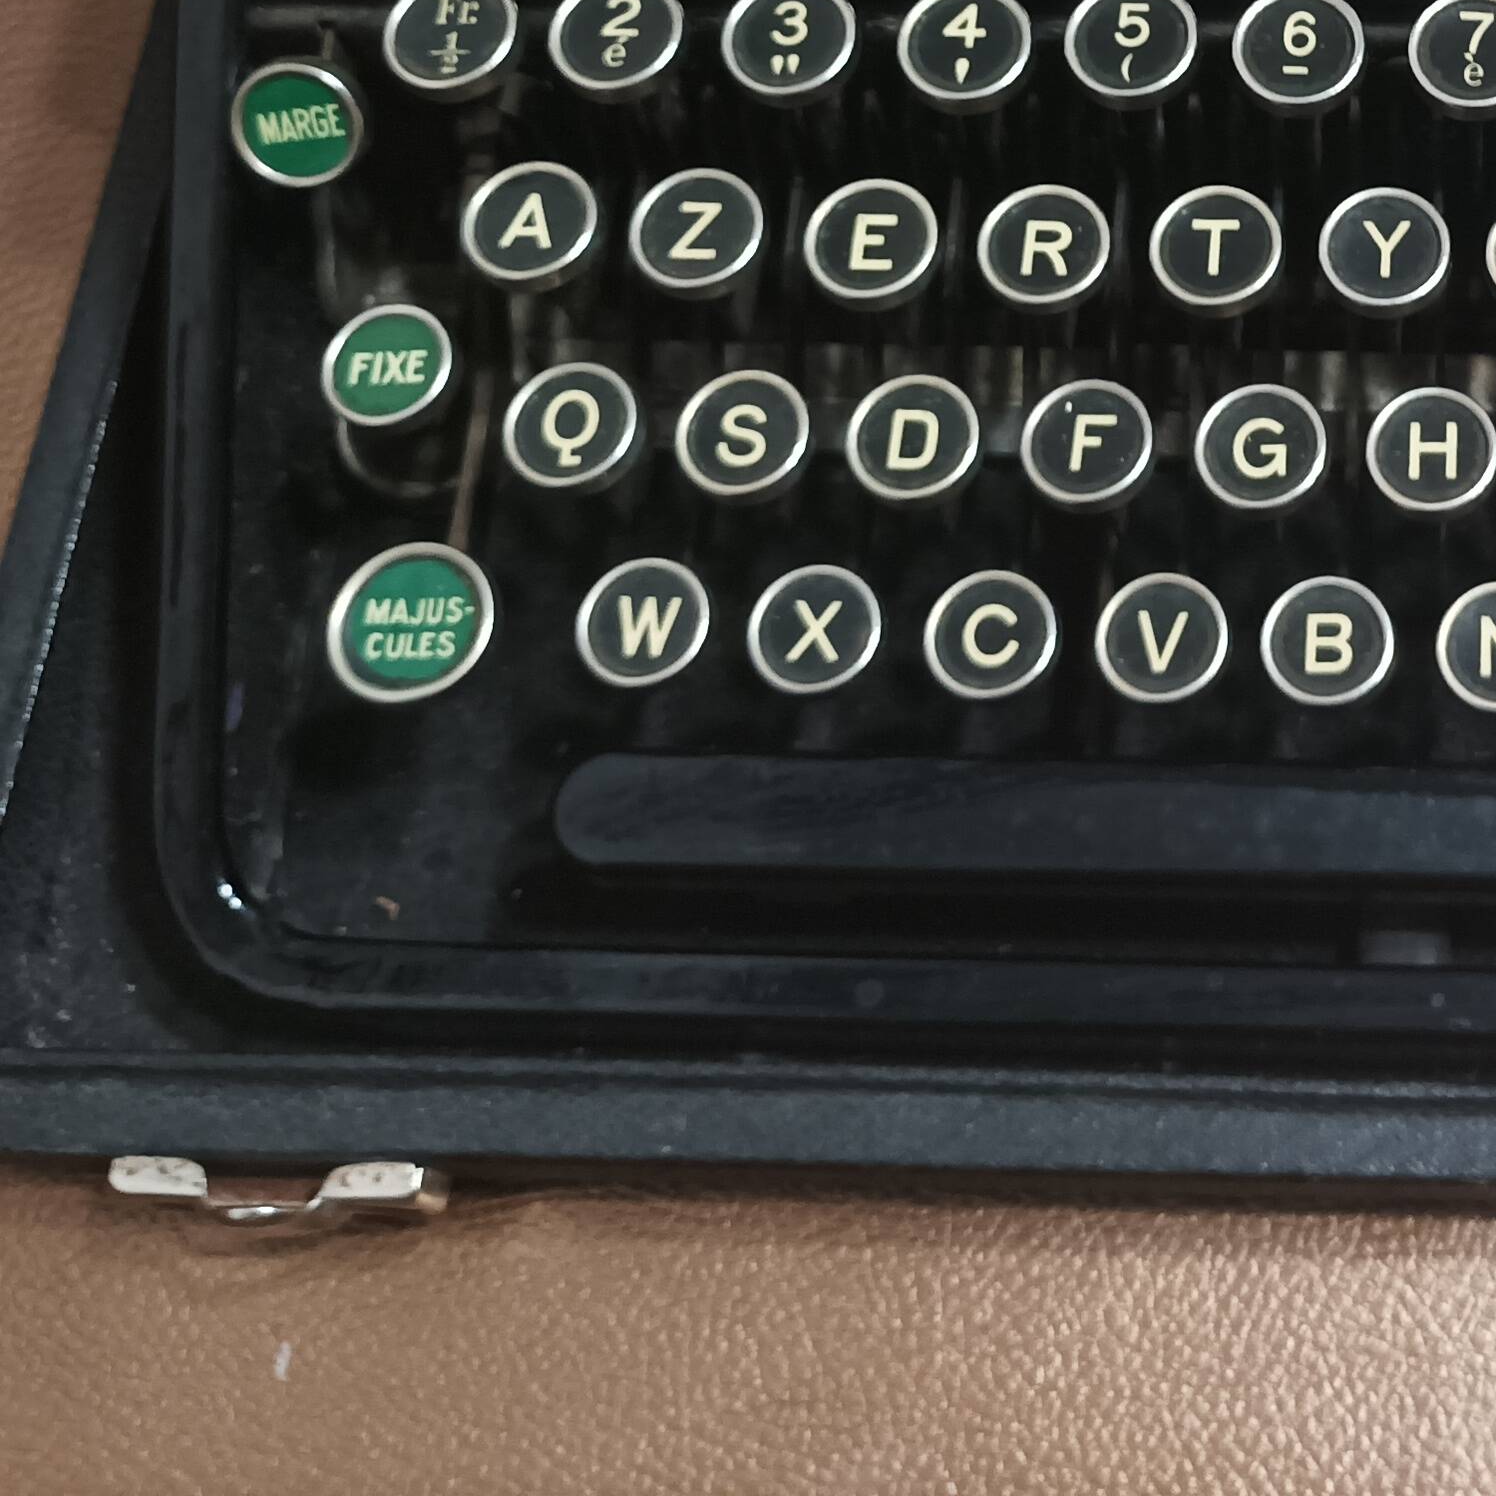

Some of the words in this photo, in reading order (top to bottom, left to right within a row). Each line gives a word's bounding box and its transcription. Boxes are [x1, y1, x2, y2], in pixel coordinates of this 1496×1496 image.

[601, 35, 628, 68] é
[771, 0, 809, 46] 3
[942, 3, 987, 49] 4
[1114, 2, 1151, 48] 5
[1283, 10, 1317, 57] 6
[1459, 10, 1495, 58] 7
[1462, 51, 1484, 87] è
[256, 102, 345, 145] MARGE
[498, 192, 552, 249] A
[667, 200, 723, 260] Z
[848, 213, 899, 271] E
[1020, 219, 1073, 276] R
[1191, 218, 1241, 276] T
[1362, 220, 1411, 279] Y
[348, 349, 429, 386] FIXE
[540, 388, 600, 467] Q
[716, 404, 767, 467] S
[886, 408, 939, 470] D
[1068, 414, 1118, 472] F
[1232, 417, 1287, 479] G
[1408, 421, 1458, 481] H
[364, 598, 475, 625] MAJUS-
[618, 594, 682, 659] W
[785, 599, 843, 663] X
[962, 603, 1020, 668] C
[365, 629, 456, 662] CULES
[1137, 609, 1189, 674] V
[1304, 612, 1353, 674] B
